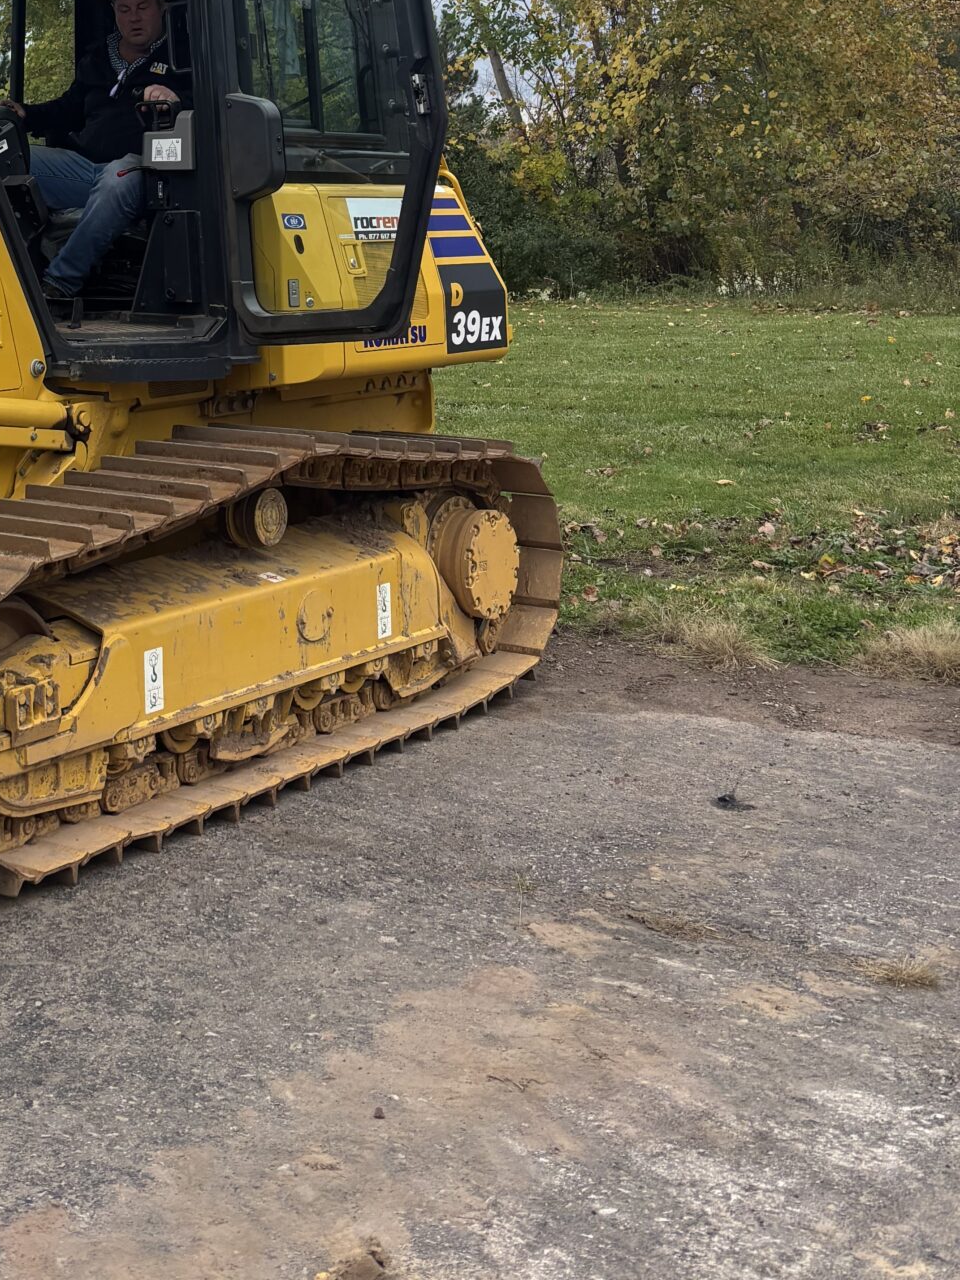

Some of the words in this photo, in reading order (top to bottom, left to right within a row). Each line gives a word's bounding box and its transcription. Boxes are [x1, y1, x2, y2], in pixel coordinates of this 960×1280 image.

[149, 61, 169, 75] CAT
[353, 216, 399, 229] rocren
[450, 282, 464, 307] D
[451, 310, 503, 345] 39EX
